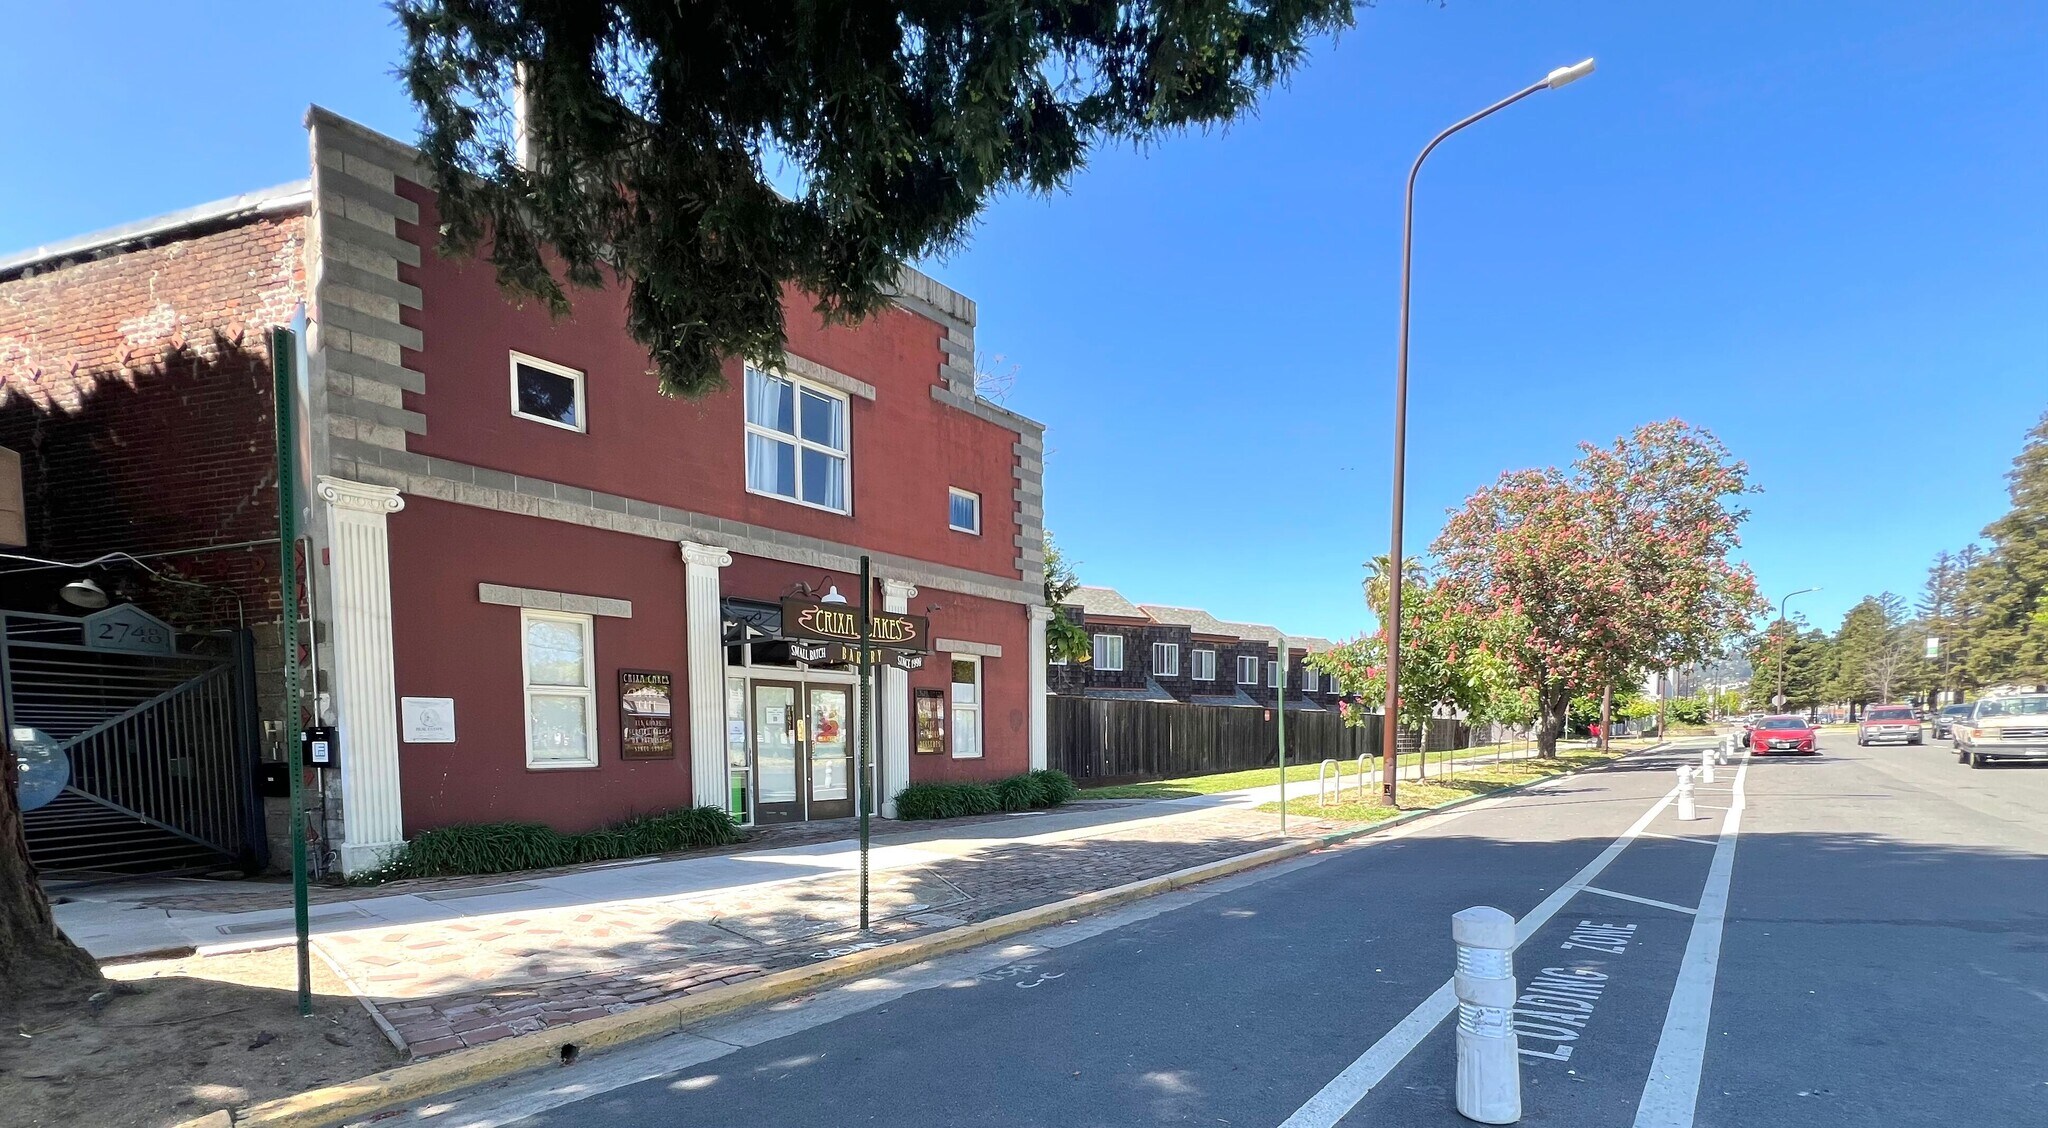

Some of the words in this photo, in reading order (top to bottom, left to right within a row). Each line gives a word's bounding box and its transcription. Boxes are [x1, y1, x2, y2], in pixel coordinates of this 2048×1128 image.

[98, 622, 162, 644] 2748
[816, 610, 856, 634] CRIXA
[868, 618, 903, 640] AKES
[791, 644, 809, 661] SMALL
[809, 647, 827, 661] BATCH
[842, 646, 882, 664] BAKRY
[897, 655, 911, 669] SINCE
[1560, 920, 1638, 955] ZONE
